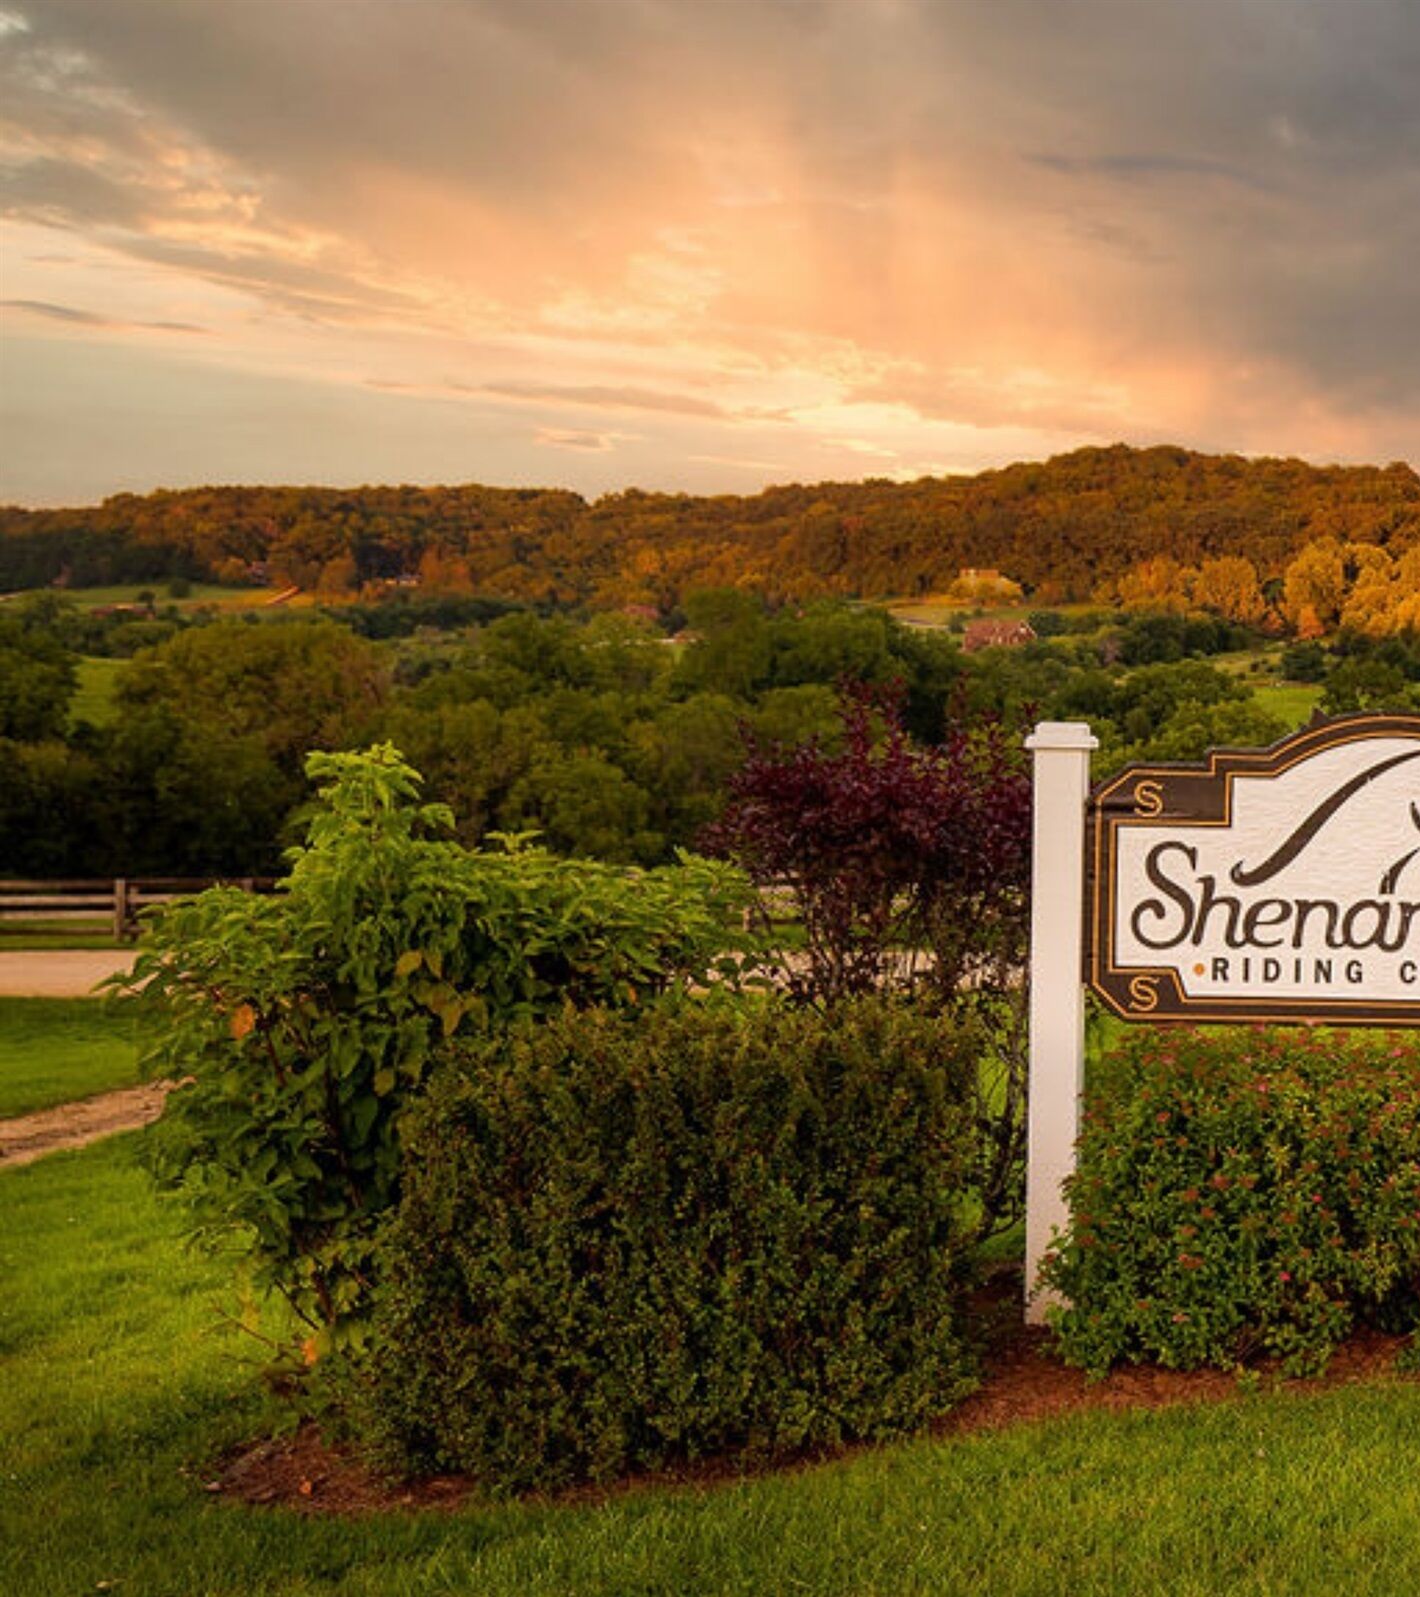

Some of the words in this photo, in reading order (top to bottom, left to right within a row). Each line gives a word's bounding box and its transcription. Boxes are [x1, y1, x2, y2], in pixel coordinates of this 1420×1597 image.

[1133, 780, 1163, 818] S
[1211, 957, 1363, 984] RIDING
[1129, 974, 1160, 1012] S
